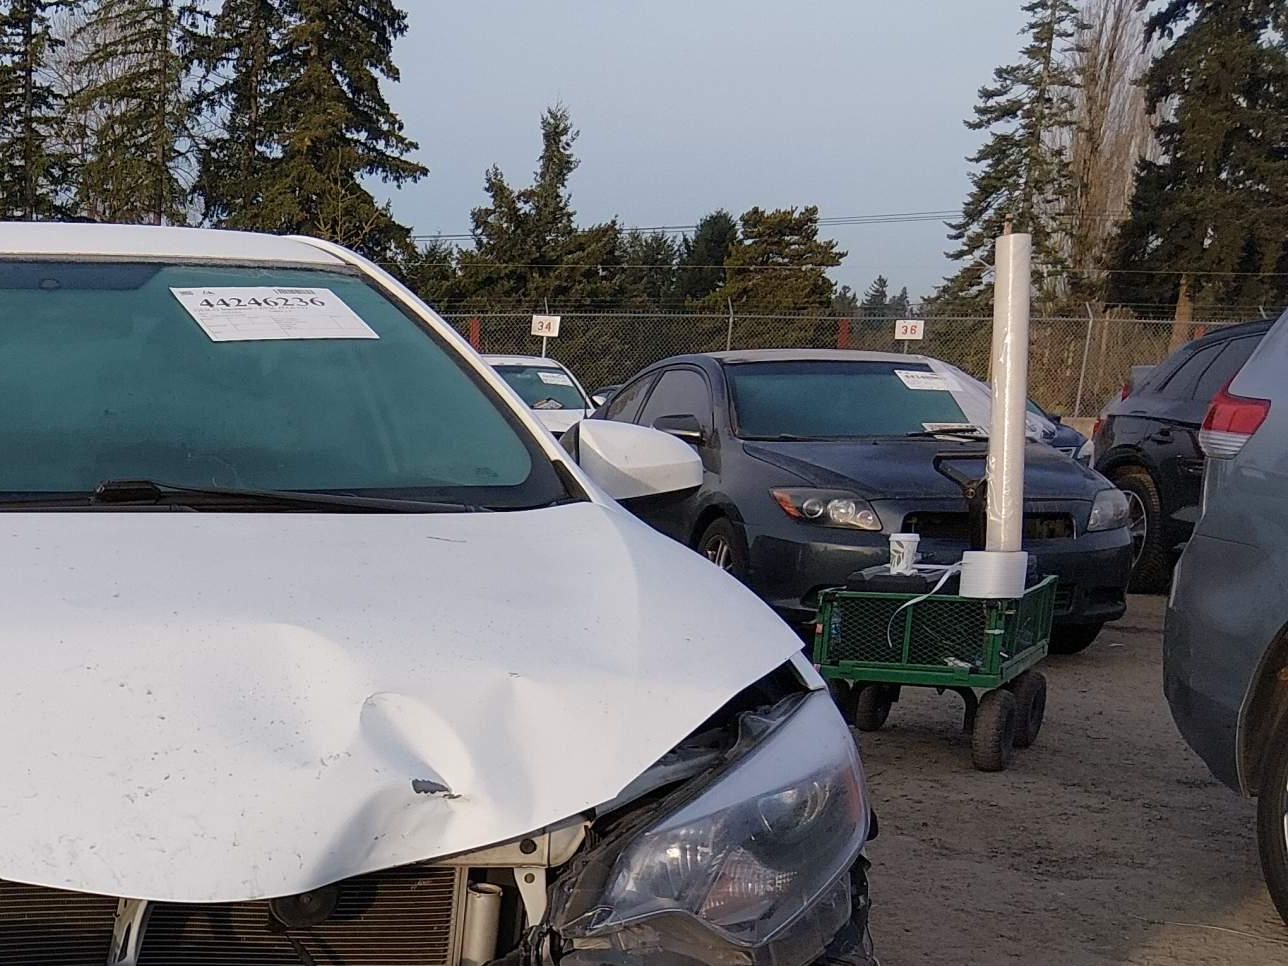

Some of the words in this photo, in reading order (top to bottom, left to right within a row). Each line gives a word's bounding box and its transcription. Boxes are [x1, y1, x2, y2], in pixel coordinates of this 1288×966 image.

[199, 296, 326, 308] 44246236
[537, 320, 552, 332] 34
[901, 325, 917, 336] 36
